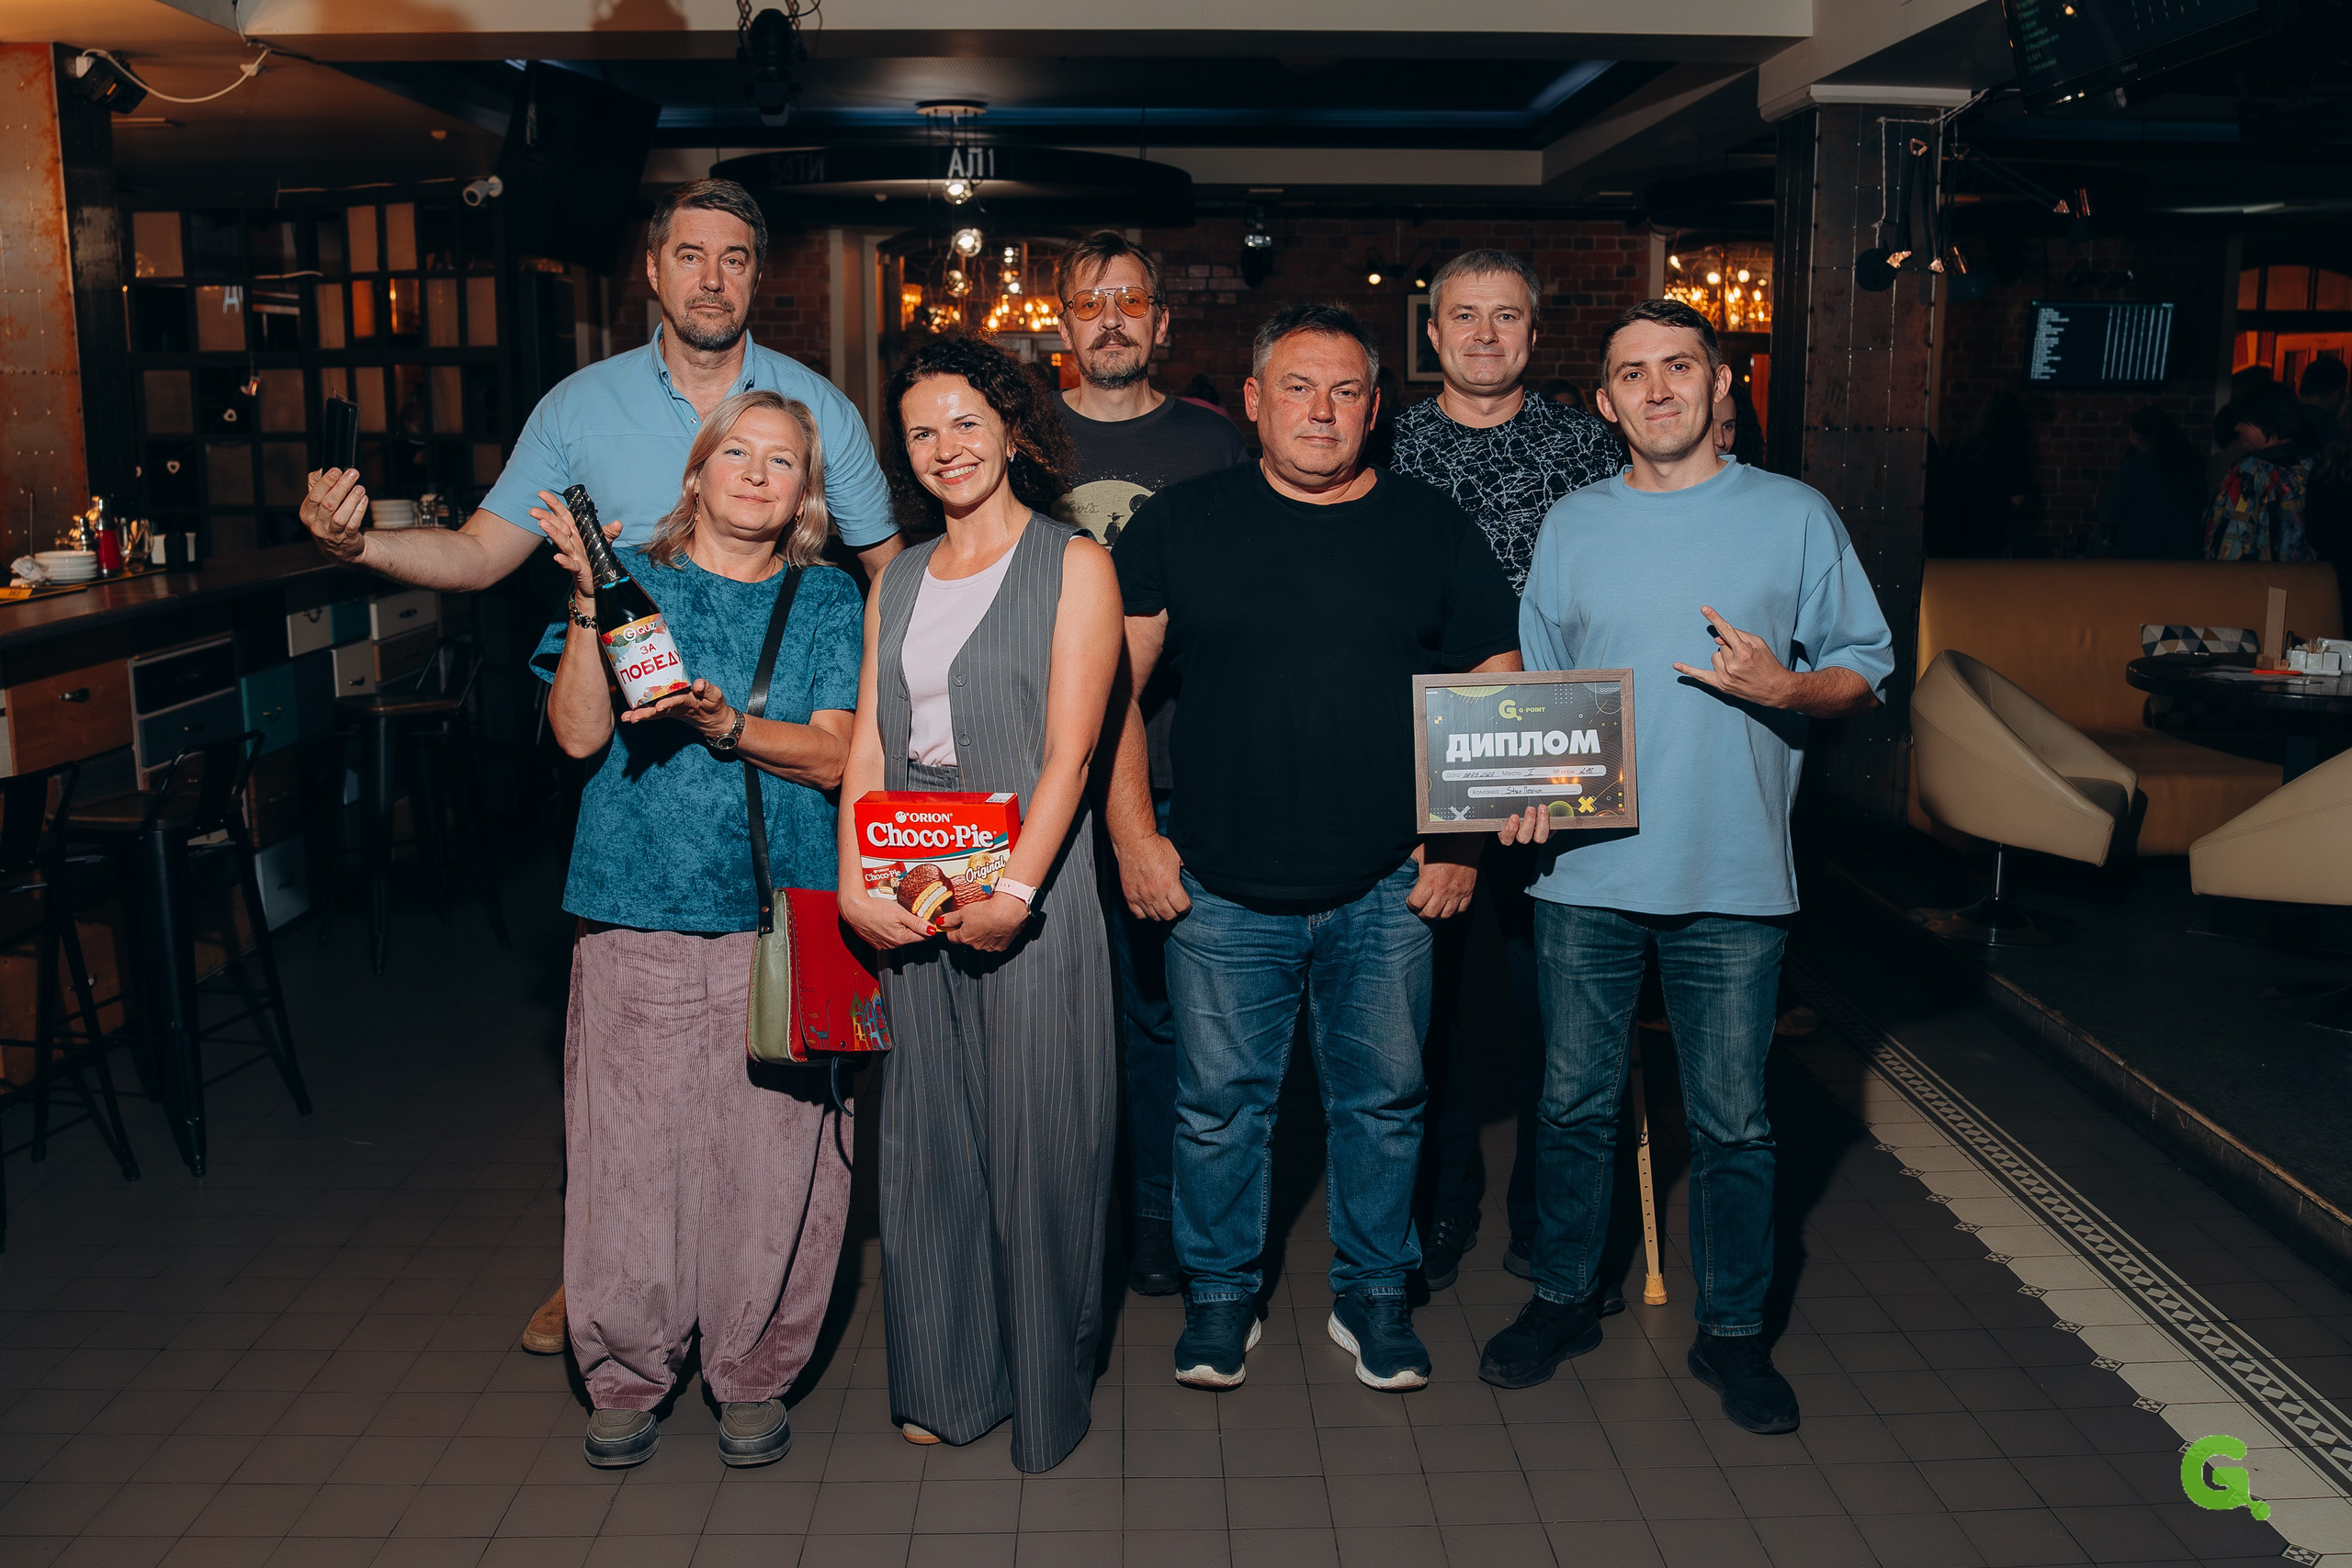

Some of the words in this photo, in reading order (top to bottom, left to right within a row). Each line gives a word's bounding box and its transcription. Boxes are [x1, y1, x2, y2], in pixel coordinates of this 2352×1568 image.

[638, 621, 658, 635] QUIZ
[639, 643, 657, 655] ЗА
[1445, 729, 1601, 763] ДИПЛОМ
[910, 812, 950, 823] ORION
[966, 855, 1007, 884] Original
